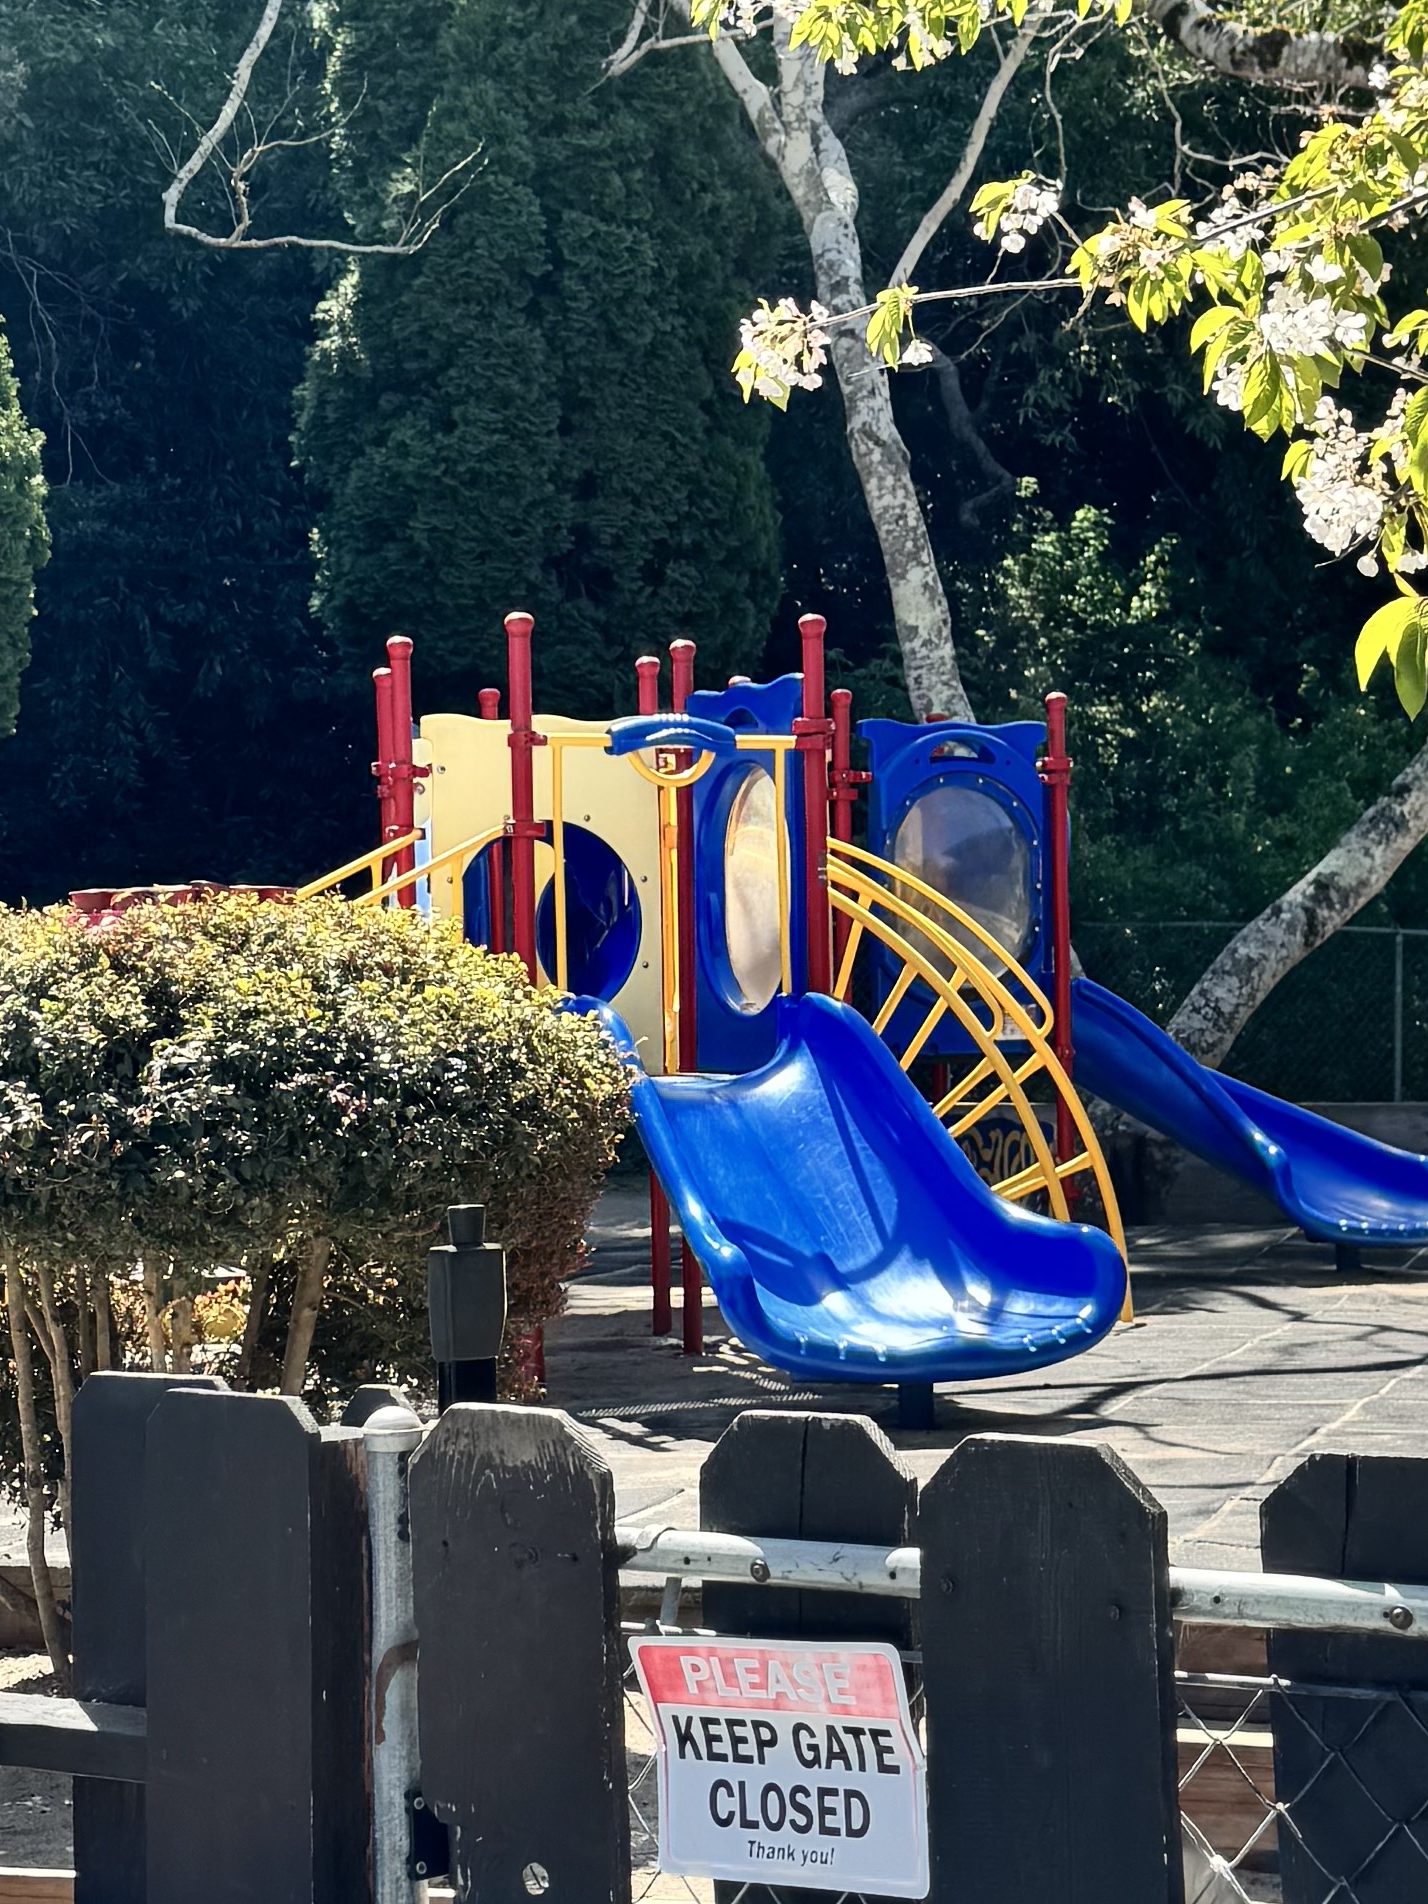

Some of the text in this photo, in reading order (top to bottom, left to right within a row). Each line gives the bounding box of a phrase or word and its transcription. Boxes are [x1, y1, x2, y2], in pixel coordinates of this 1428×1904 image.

[679, 1655, 857, 1705] PLEASE
[671, 1714, 901, 1775] KEEP GATE
[709, 1778, 871, 1839] CLOSED
[747, 1840, 835, 1866] Thank you!
